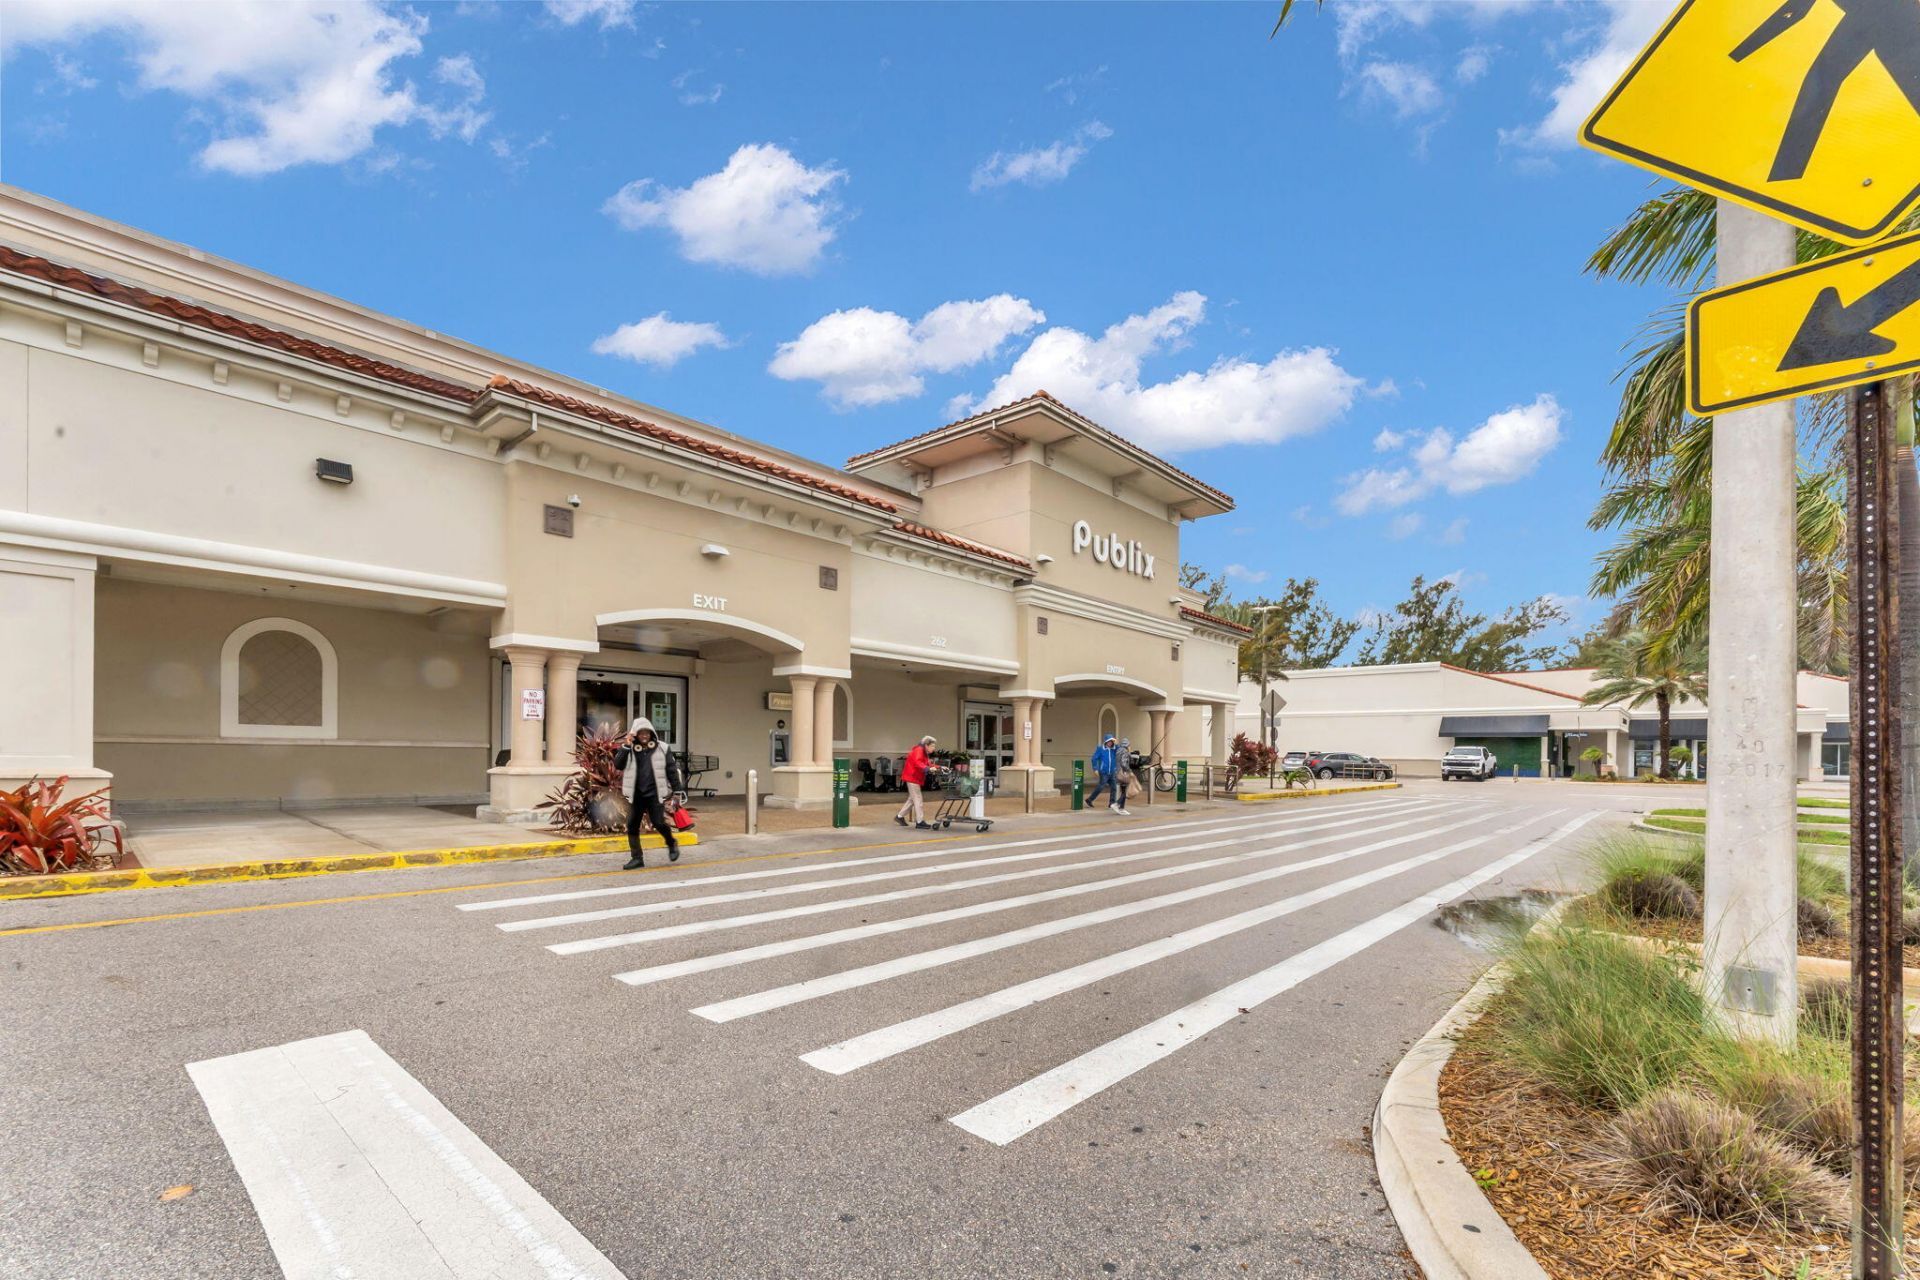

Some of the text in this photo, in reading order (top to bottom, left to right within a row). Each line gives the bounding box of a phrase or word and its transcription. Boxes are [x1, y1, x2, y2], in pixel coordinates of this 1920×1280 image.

[1073, 519, 1155, 580] Publix
[693, 593, 728, 611] EXIT
[1106, 664, 1125, 675] ENTRY
